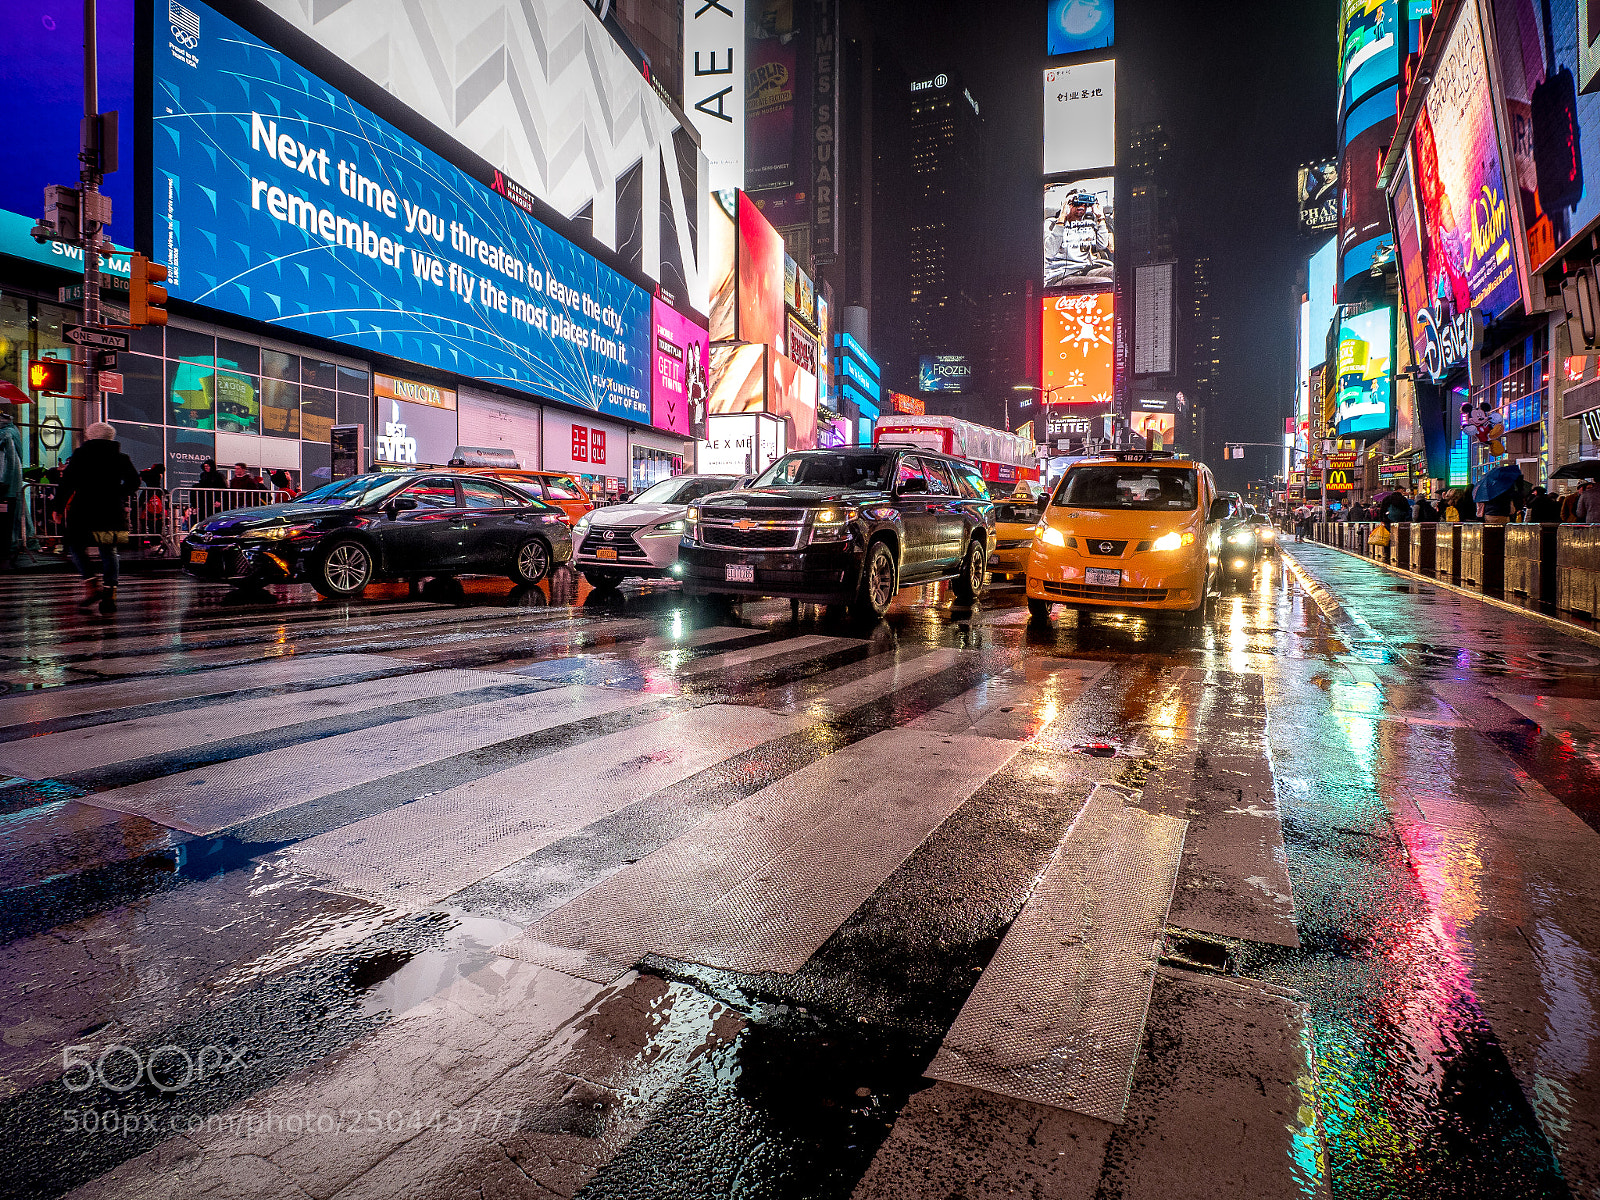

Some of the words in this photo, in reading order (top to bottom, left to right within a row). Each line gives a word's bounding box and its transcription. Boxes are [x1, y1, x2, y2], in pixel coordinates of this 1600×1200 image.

[694, 47, 733, 123] AE
[910, 80, 933, 92] lianz
[1056, 88, 1103, 102] 创业圣地
[815, 104, 834, 225] SQUARE
[507, 180, 535, 205] MARRIOTT
[507, 189, 532, 211] MARQUIS
[252, 111, 330, 187] Next
[338, 160, 397, 219] time
[403, 198, 445, 243] you
[450, 220, 524, 283] threaten
[527, 261, 543, 292] to
[546, 267, 580, 311] leave
[582, 287, 600, 321] the
[602, 304, 624, 337] city,
[1301, 204, 1337, 221] PHAN
[1306, 216, 1318, 225] OF
[1320, 213, 1337, 223] THE
[1464, 185, 1506, 273] Aladdin
[51, 239, 104, 268] SWIS
[108, 256, 131, 272] MA
[252, 176, 405, 269] remember
[411, 249, 444, 287] we
[449, 262, 475, 304] fly
[480, 277, 509, 314] the
[511, 295, 549, 332] most
[551, 311, 589, 350] places
[591, 328, 617, 361] from
[618, 340, 628, 365] it.
[73, 286, 81, 298] 45
[113, 276, 129, 290] Bro
[72, 330, 92, 341] ONE
[101, 335, 120, 346] WAY
[659, 355, 673, 378] GET
[933, 363, 972, 378] FROZEN
[393, 379, 442, 404] INVICTA
[592, 374, 607, 389] FLY
[612, 381, 640, 400] UNITED
[608, 393, 623, 405] OUT
[623, 398, 632, 409] OF
[1313, 382, 1321, 452] PALACE
[1583, 409, 1600, 441] FO
[377, 436, 417, 464] EVER
[1380, 464, 1408, 473] ELECTRONICS
